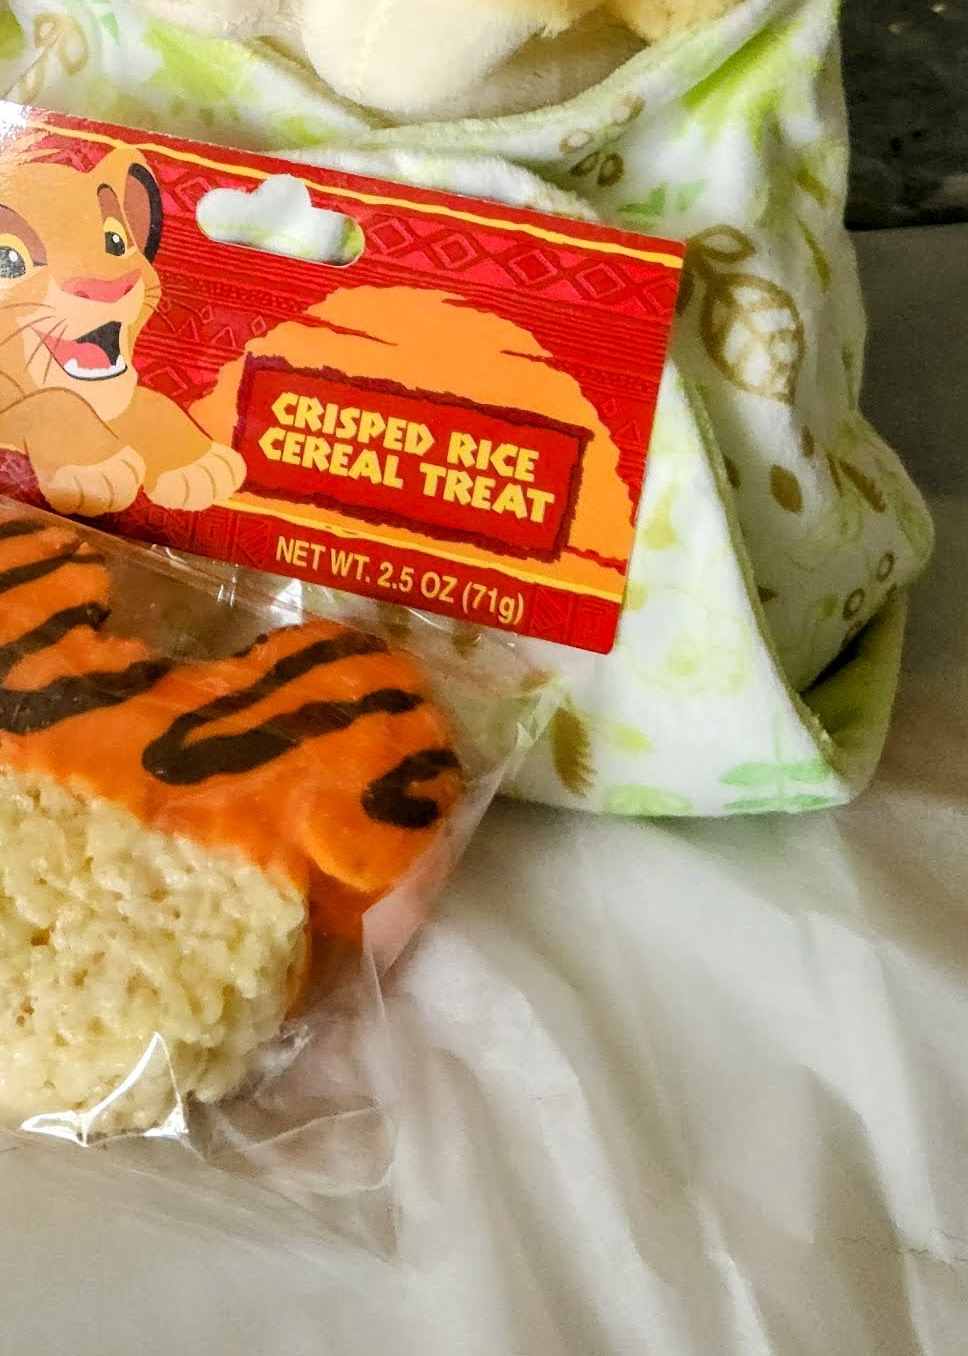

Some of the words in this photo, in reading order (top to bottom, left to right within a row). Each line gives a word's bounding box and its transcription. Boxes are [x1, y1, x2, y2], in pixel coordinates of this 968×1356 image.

[257, 426, 404, 489] CEREAL
[419, 462, 555, 524] TREAT
[270, 391, 436, 457] CRISPED
[446, 431, 540, 482] RICE
[275, 535, 326, 571] NET
[330, 549, 371, 584] WT.
[376, 560, 414, 594] 2.5
[419, 571, 456, 604] OZ
[461, 580, 525, 625] (71g)
